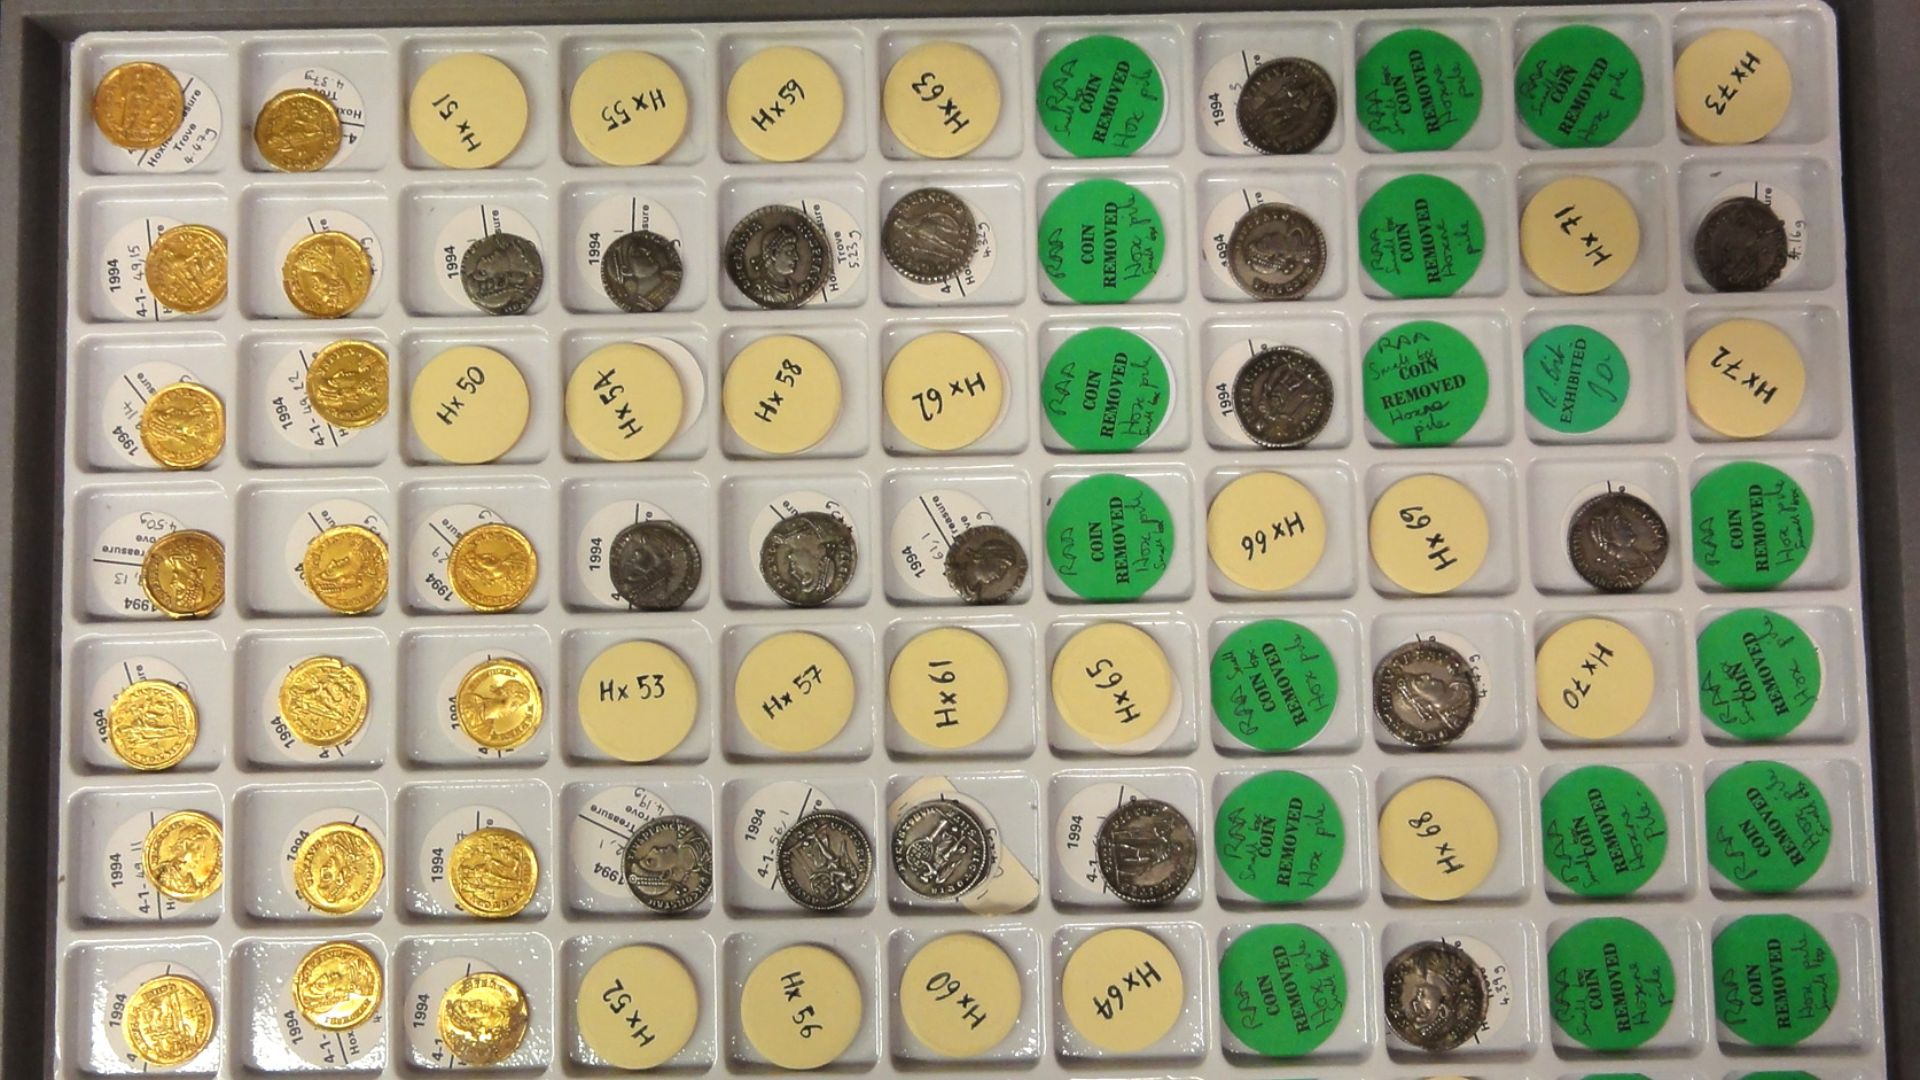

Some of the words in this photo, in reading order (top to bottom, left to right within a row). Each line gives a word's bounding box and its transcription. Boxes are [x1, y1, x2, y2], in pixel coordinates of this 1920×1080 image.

[778, 79, 805, 105] 59
[911, 72, 944, 101] 63
[1079, 73, 1102, 114] COIN
[1092, 61, 1130, 143] REMOVED
[1391, 74, 1412, 115] COIN
[1409, 50, 1440, 134] REMOVED
[1551, 65, 1579, 104] COIN
[1558, 58, 1609, 136] REMOVED
[1705, 84, 1738, 115] 73
[432, 94, 458, 120] 51
[601, 100, 631, 131] 55
[1208, 92, 1225, 126] 1994
[147, 135, 172, 167] Hoxn
[172, 123, 196, 151] Trove
[1554, 204, 1583, 236] 71
[589, 232, 600, 266] 1994
[834, 231, 846, 264] Trove
[1081, 224, 1095, 264] COIN
[1103, 201, 1117, 288] REMOVED
[1398, 223, 1414, 263] COIN
[1415, 198, 1440, 284] REMOVED
[108, 258, 120, 292] 1994
[444, 245, 459, 279] 1994
[457, 366, 485, 394] 50
[775, 359, 802, 388] 58
[1399, 358, 1439, 381] COIN
[1560, 337, 1587, 424] EXHIBITED
[1710, 346, 1744, 380] 72
[593, 368, 625, 405] 54
[1082, 369, 1102, 410] COIN
[1100, 352, 1127, 439] REMOVED
[1216, 383, 1234, 416] 1994
[1380, 374, 1467, 409] REMOVED
[272, 396, 294, 430] 1994
[912, 388, 943, 421] 62
[112, 426, 139, 457] 1994
[1399, 506, 1430, 529] 69
[1727, 508, 1744, 550] COIN
[1749, 484, 1769, 572] REMOVED
[102, 544, 146, 558] reasure
[589, 538, 602, 571] 1994
[1088, 521, 1104, 562] COIN
[1109, 496, 1130, 584] REMOVED
[1241, 530, 1266, 560] 66
[902, 545, 926, 578] 1994
[425, 572, 454, 602] 1994
[636, 674, 665, 700] 53
[792, 664, 822, 694] 57
[928, 660, 956, 683] 61
[1086, 659, 1123, 688] 65
[1261, 642, 1308, 727] REMOVED
[1726, 662, 1758, 703] COIN
[1742, 631, 1790, 716] REMOVED
[1249, 672, 1276, 714] COIN
[1563, 677, 1591, 709] 70
[93, 708, 108, 743] 1994
[270, 716, 295, 749] 1994
[590, 804, 636, 833] Treasure
[745, 807, 766, 842] 1994
[1066, 814, 1083, 849] 1994
[1408, 811, 1441, 837] 68
[1572, 815, 1598, 857] COIN
[1587, 787, 1628, 875] REMOVED
[1746, 787, 1806, 868] REMOVED
[1258, 815, 1277, 858] COIN
[1277, 797, 1303, 888] REMOVED
[1739, 818, 1771, 858] COIN
[110, 852, 122, 888] 1994
[431, 848, 444, 882] 1994
[594, 861, 626, 885] 1994
[602, 979, 631, 1014] 52
[926, 972, 960, 1001] 60
[1256, 975, 1280, 1016] COIN
[1273, 945, 1310, 1034] REMOVED
[1584, 969, 1604, 1011] COIN
[1603, 942, 1632, 1033] REMOVED
[1746, 963, 1765, 1007] COIN
[1766, 938, 1792, 1030] REMOVED
[109, 993, 127, 1028] 1994
[412, 993, 430, 1028] 1994
[1093, 986, 1124, 1020] 64
[287, 1010, 303, 1045] 1994
[792, 1005, 823, 1038] 56
[350, 1032, 360, 1056] Hox
